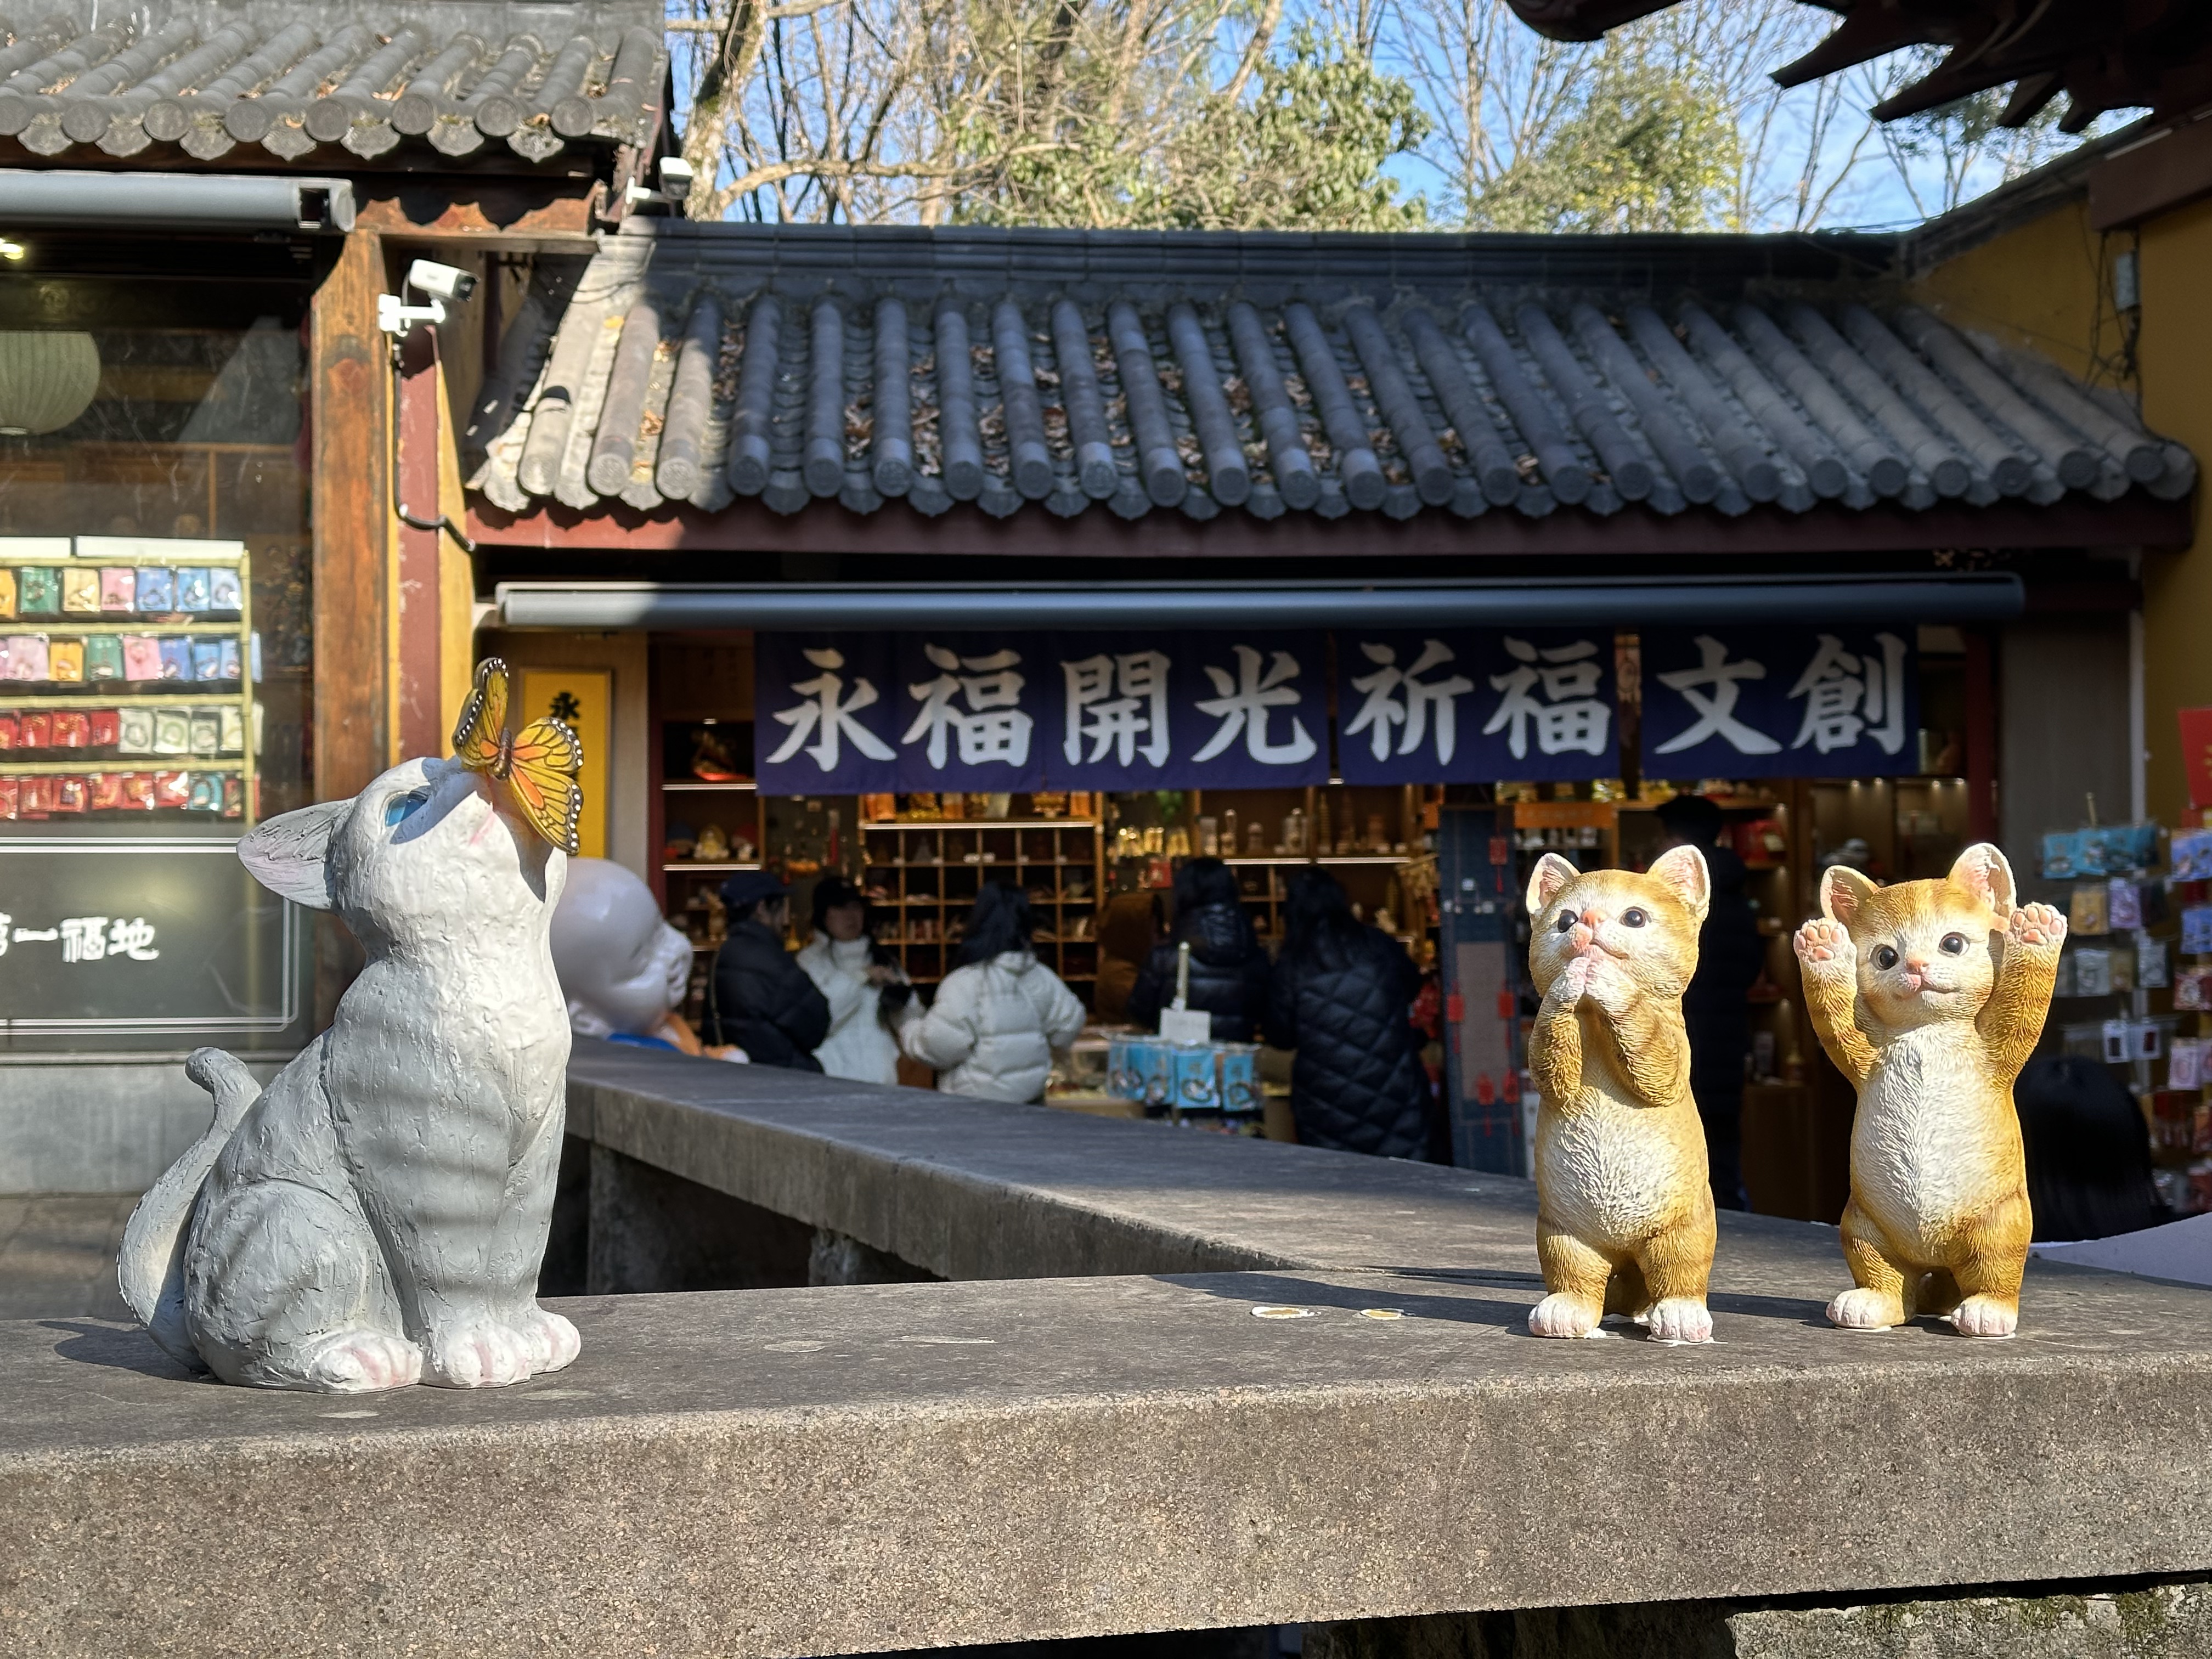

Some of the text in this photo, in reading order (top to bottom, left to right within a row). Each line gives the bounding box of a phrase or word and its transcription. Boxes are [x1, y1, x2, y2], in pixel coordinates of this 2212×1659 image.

[765, 632, 1908, 772] 永福開光祈福文創
[0, 912, 160, 963] 一福地
